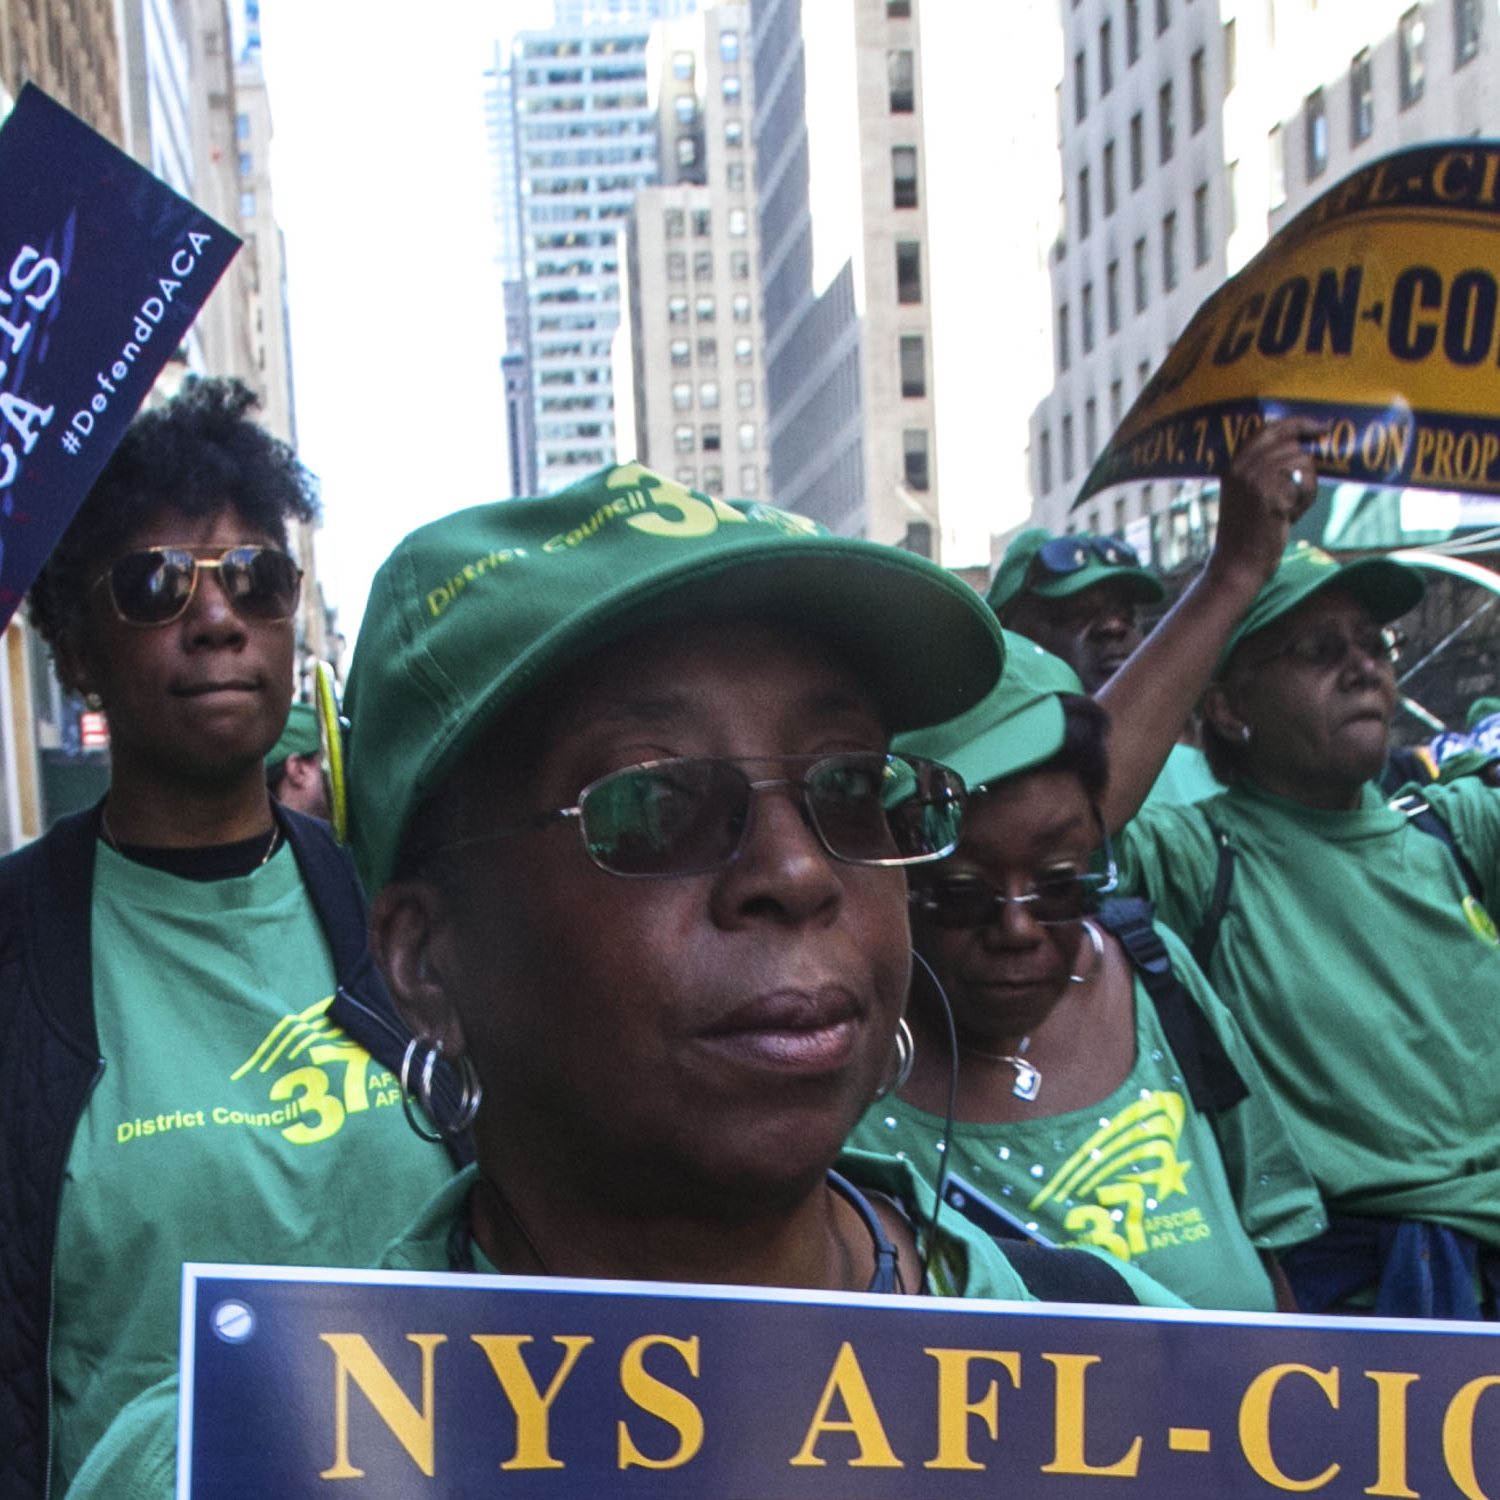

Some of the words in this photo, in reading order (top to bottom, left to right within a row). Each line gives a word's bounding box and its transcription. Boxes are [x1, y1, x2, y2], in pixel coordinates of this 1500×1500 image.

[61, 230, 212, 456] #DefendDACA
[1411, 424, 1498, 482] PROP
[541, 489, 648, 554] Council
[117, 1110, 204, 1144] District
[212, 1101, 301, 1127] Council
[269, 1044, 371, 1145] 37
[1064, 1182, 1148, 1263] 37
[319, 1331, 707, 1482] NYS
